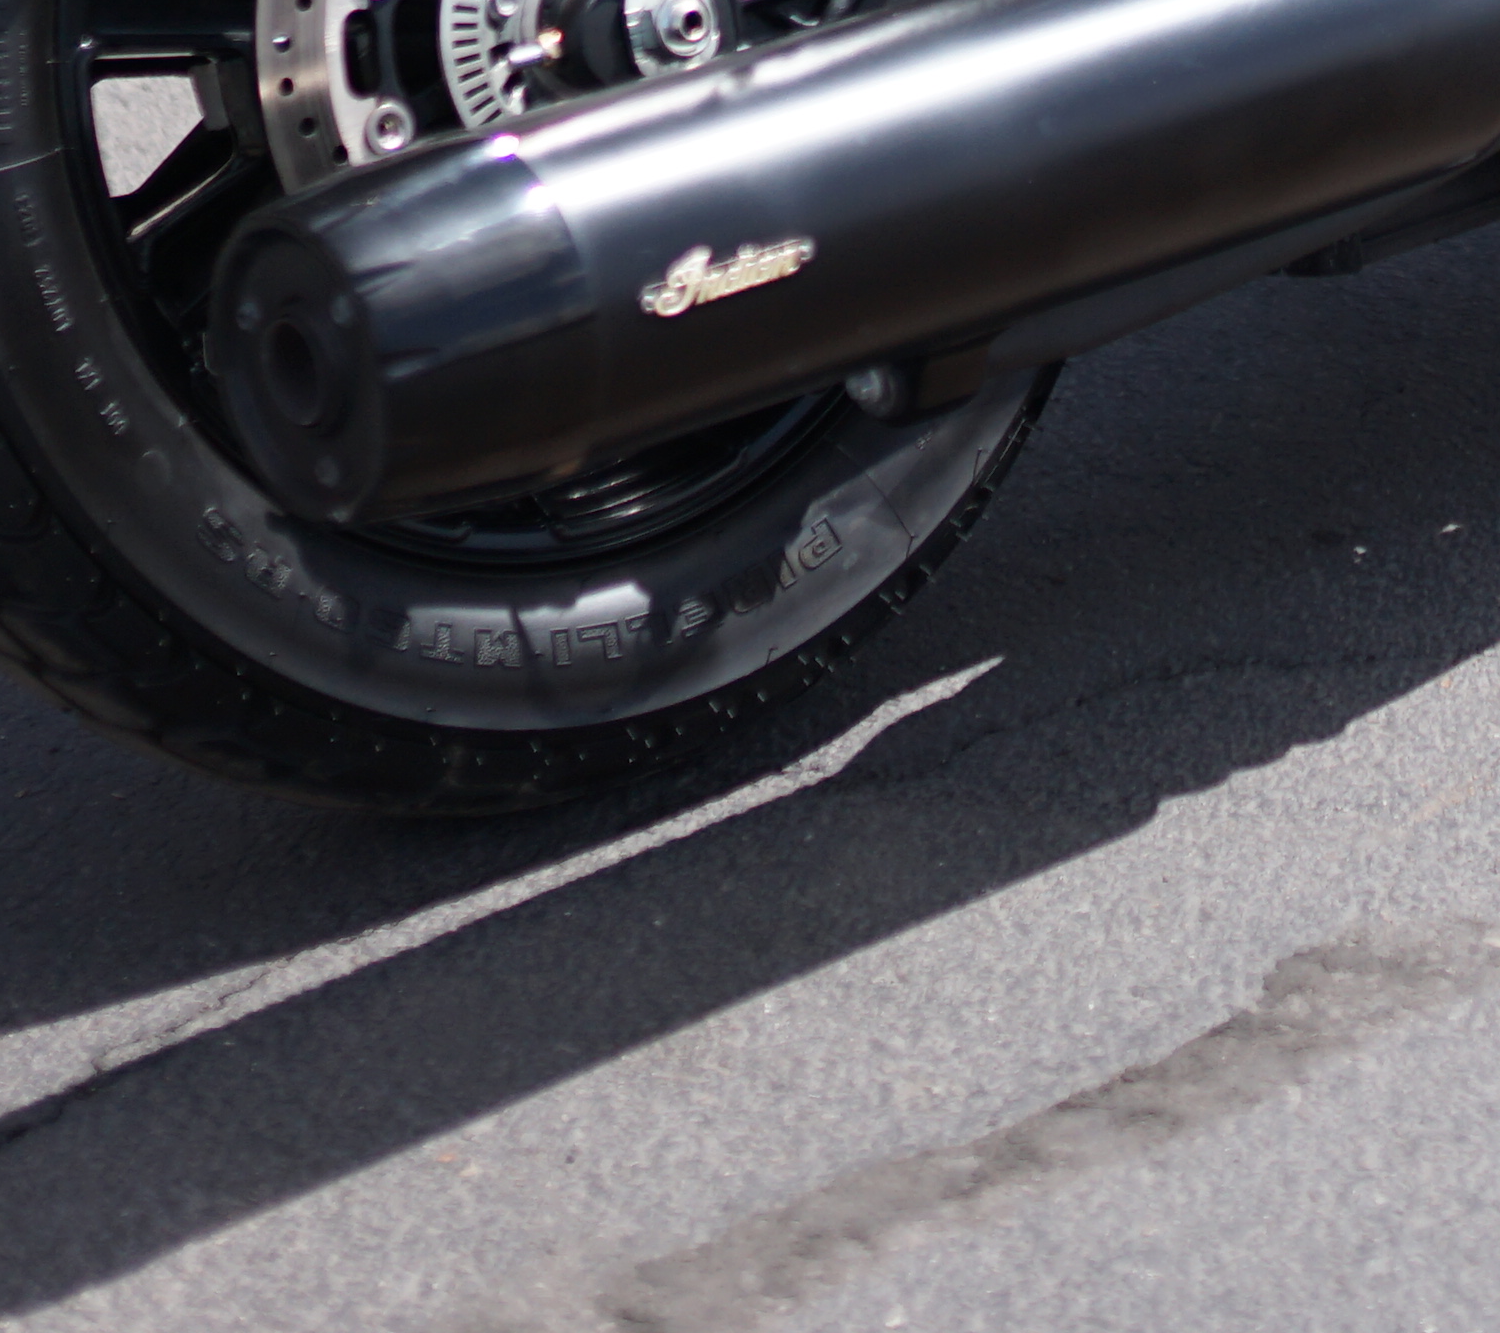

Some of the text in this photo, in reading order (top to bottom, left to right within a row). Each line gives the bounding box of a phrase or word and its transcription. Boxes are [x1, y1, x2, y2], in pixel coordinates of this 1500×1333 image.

[650, 237, 806, 318] Indian
[200, 505, 844, 668] PIRELLI MT60 RS
